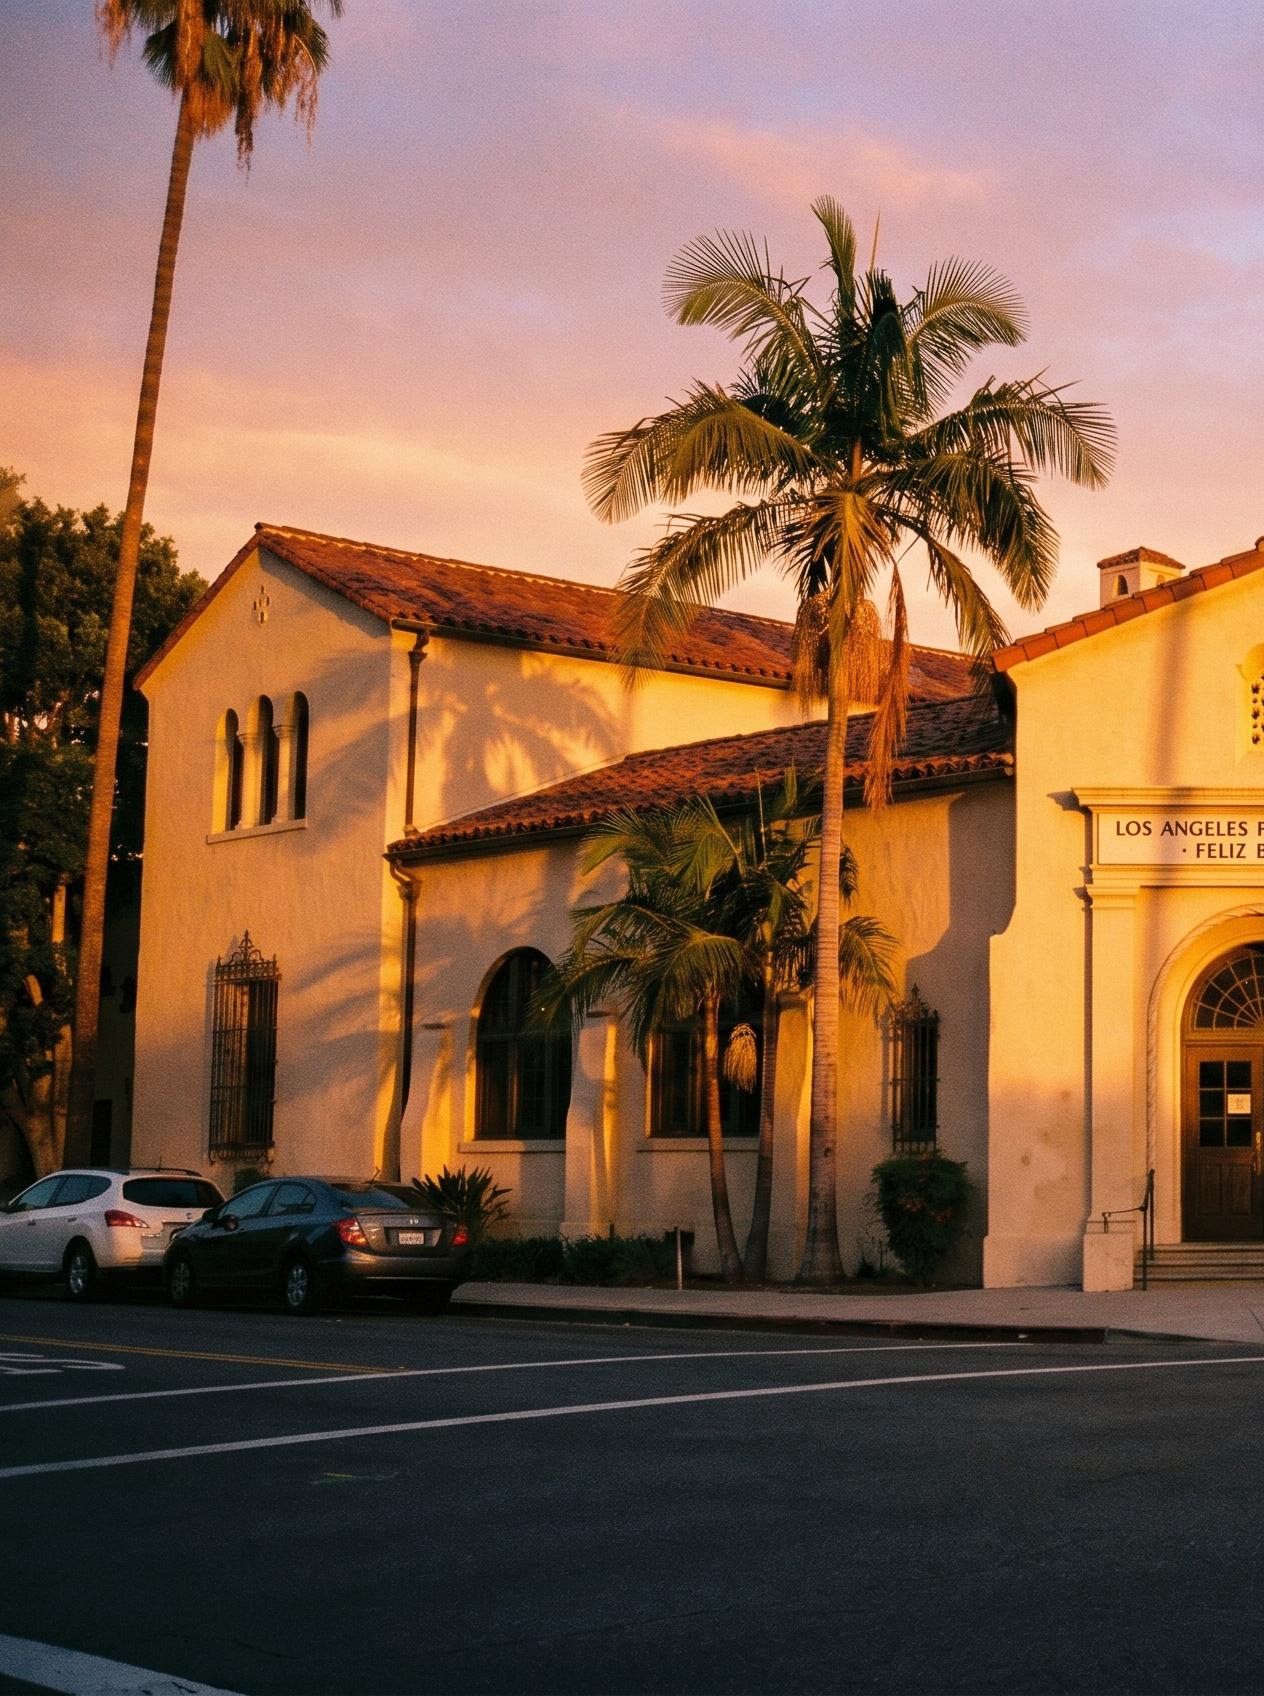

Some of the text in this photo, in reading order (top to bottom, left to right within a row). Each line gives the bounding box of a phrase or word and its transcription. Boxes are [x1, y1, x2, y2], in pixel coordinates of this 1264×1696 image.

[1116, 820, 1153, 837] LOS
[1159, 820, 1249, 838] ANGELES
[1196, 842, 1247, 859] FELIZ
